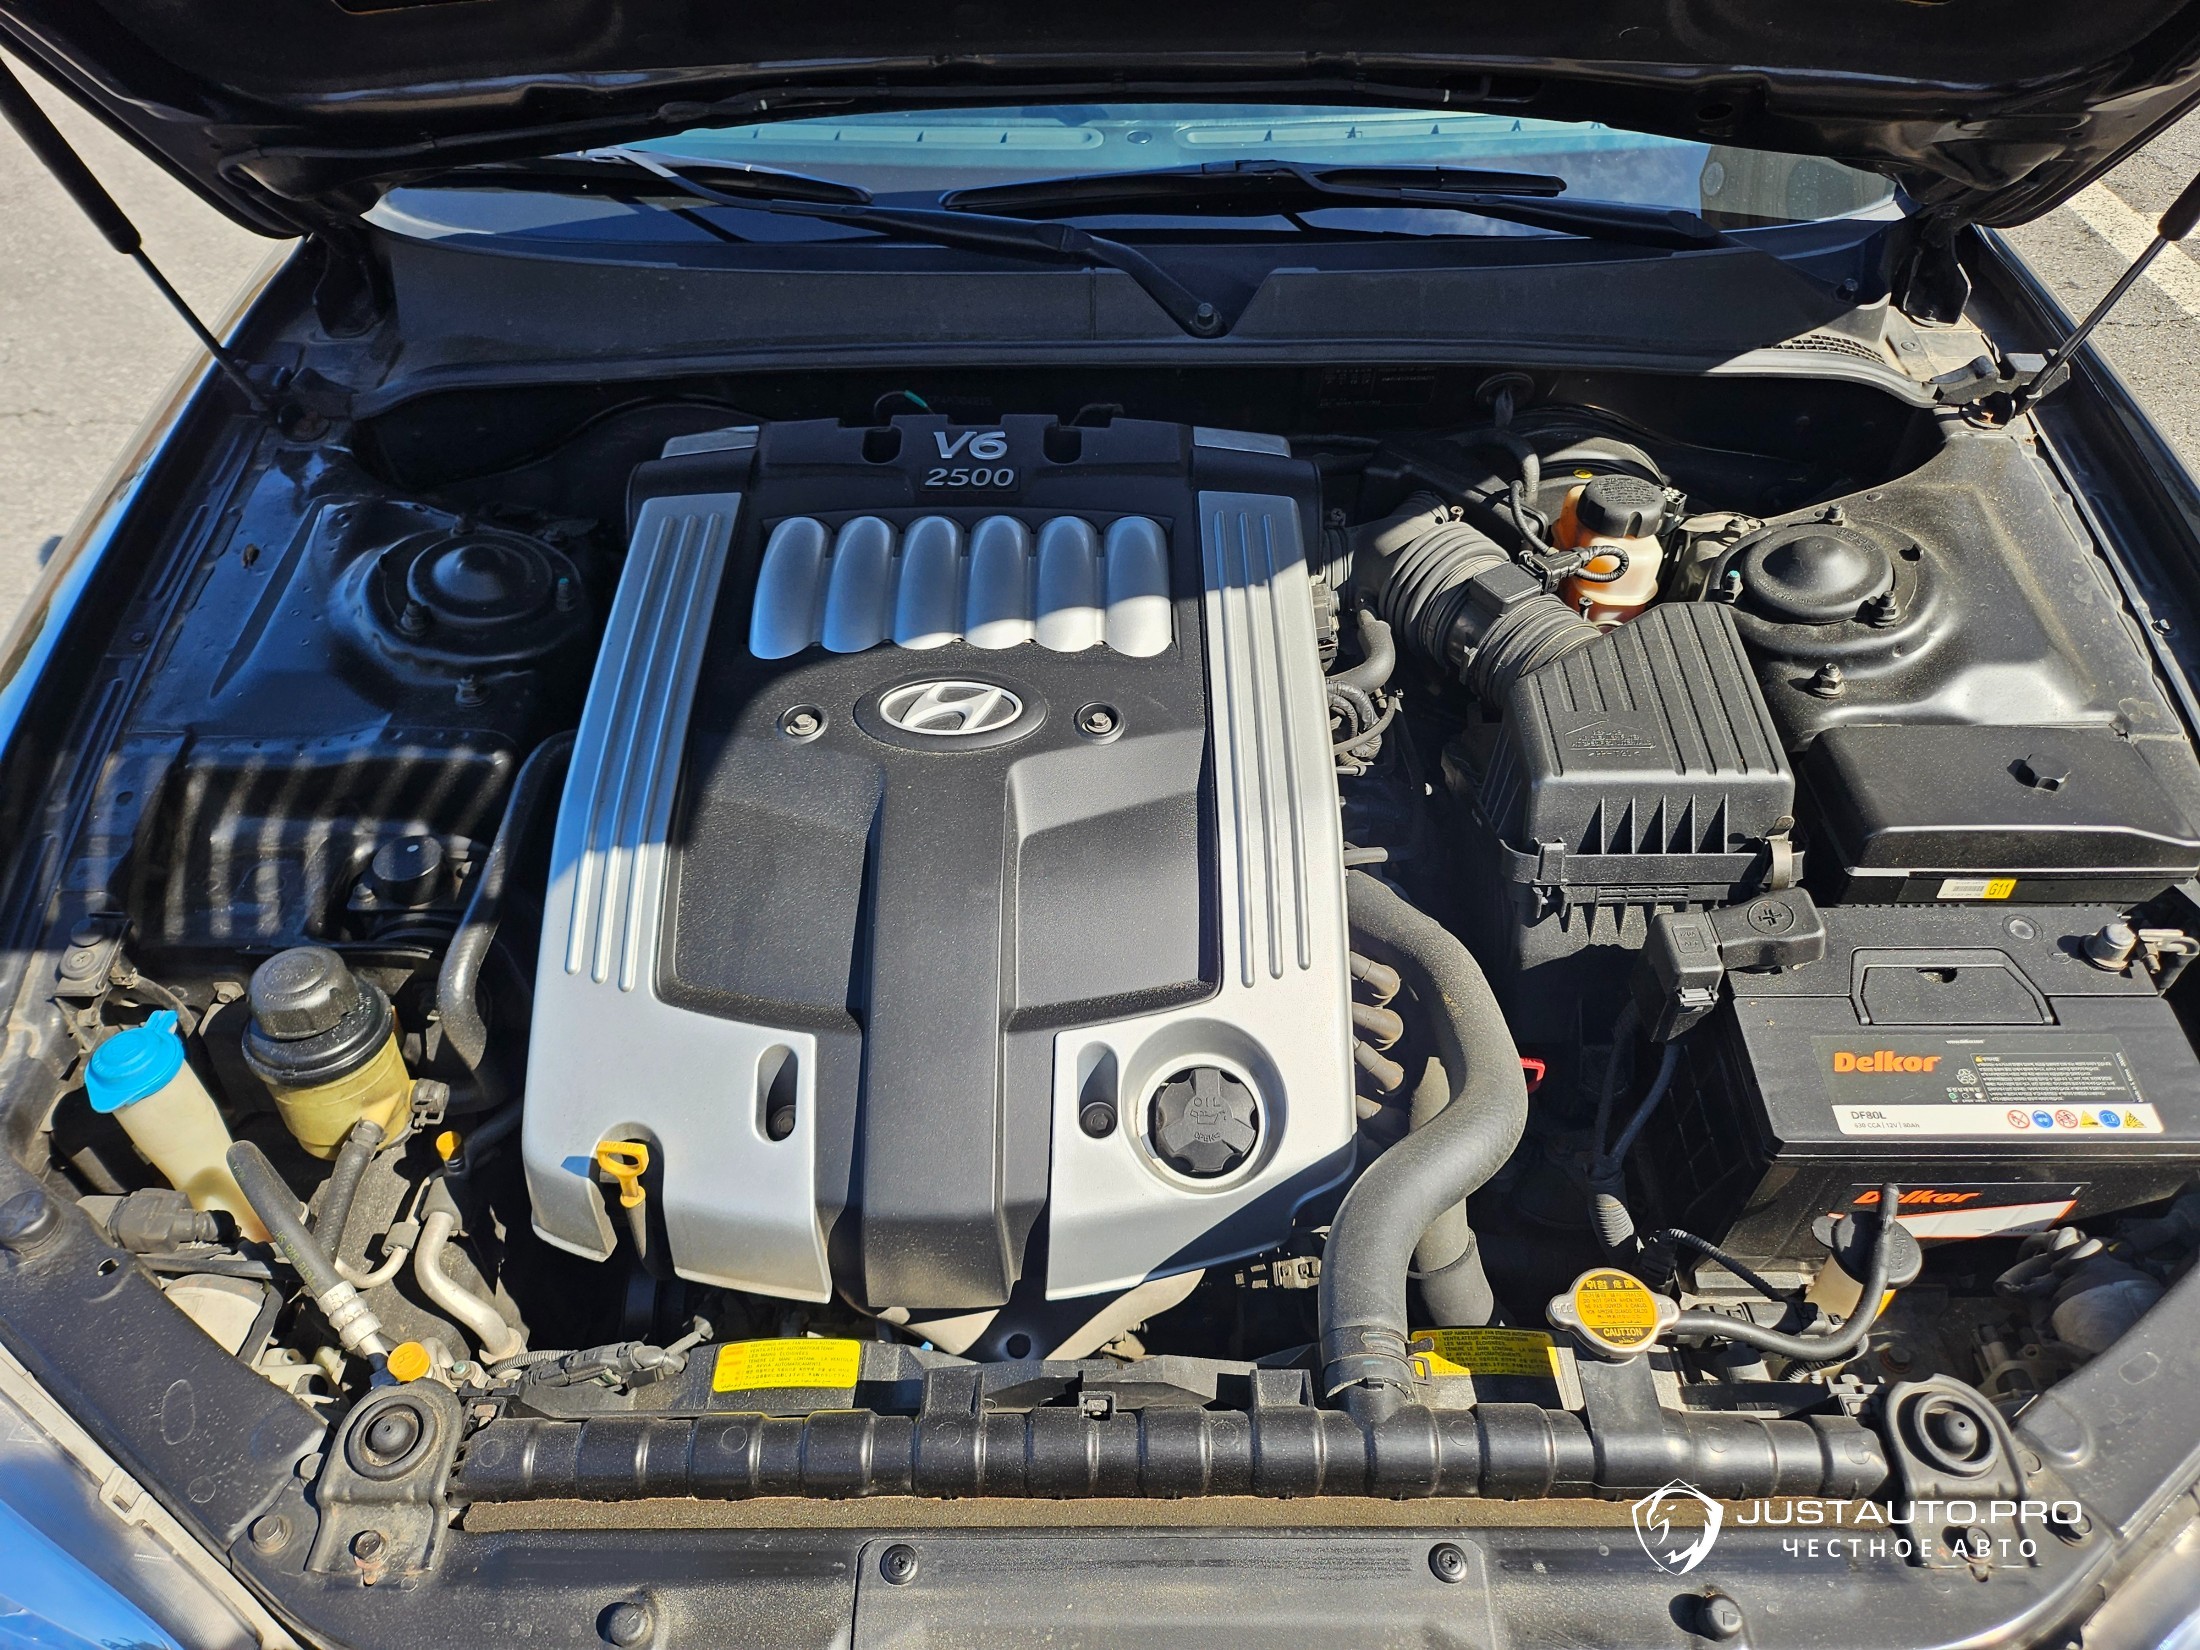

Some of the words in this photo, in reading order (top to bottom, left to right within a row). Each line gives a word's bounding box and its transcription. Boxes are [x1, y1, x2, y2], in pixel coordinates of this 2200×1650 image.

[934, 431, 1008, 460] V6
[925, 468, 1014, 486] 2500
[1988, 883, 2010, 896] G11
[1834, 1050, 1941, 1073] Delkor
[1194, 1097, 1220, 1108] OIL
[1850, 1111, 1886, 1120] DF80L
[1853, 1190, 1981, 1204] Dlkor
[1603, 1327, 1643, 1337] CAUTION
